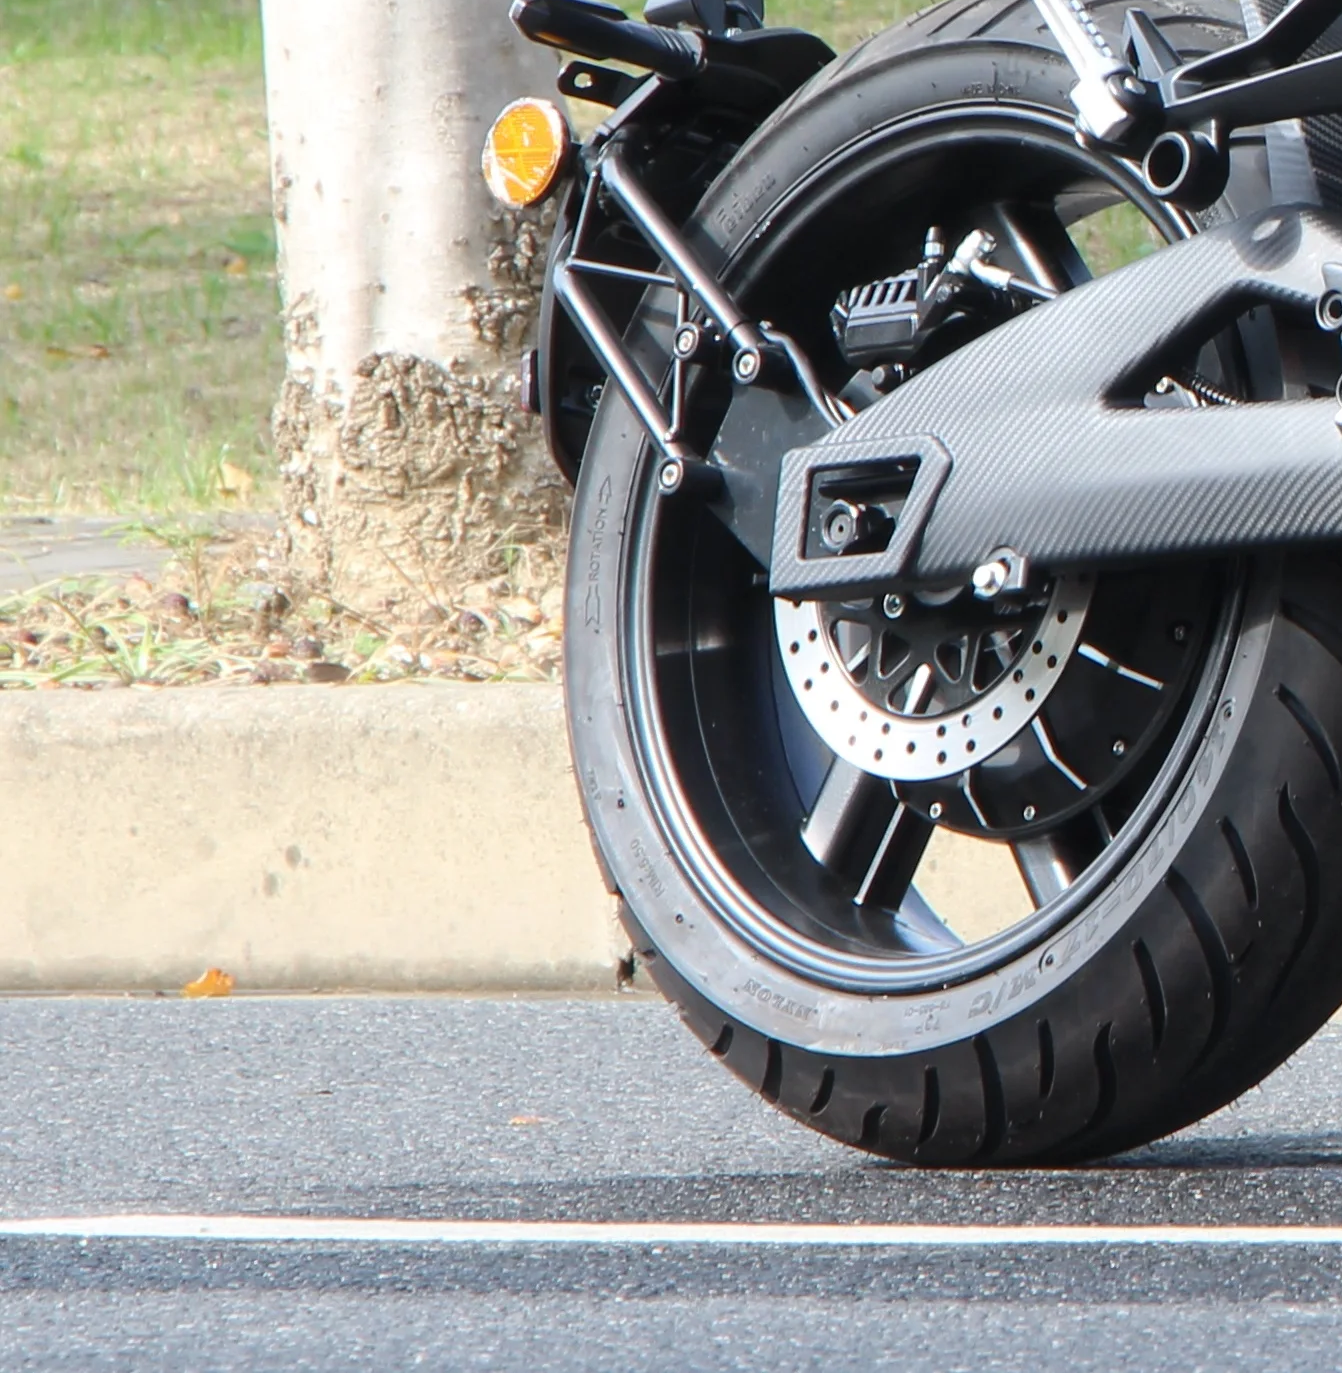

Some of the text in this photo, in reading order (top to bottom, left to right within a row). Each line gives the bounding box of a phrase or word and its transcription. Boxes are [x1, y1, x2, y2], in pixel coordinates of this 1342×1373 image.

[588, 507, 607, 582] ROTATION
[743, 977, 813, 1021] NYLON
[968, 973, 1039, 1019] M/C
